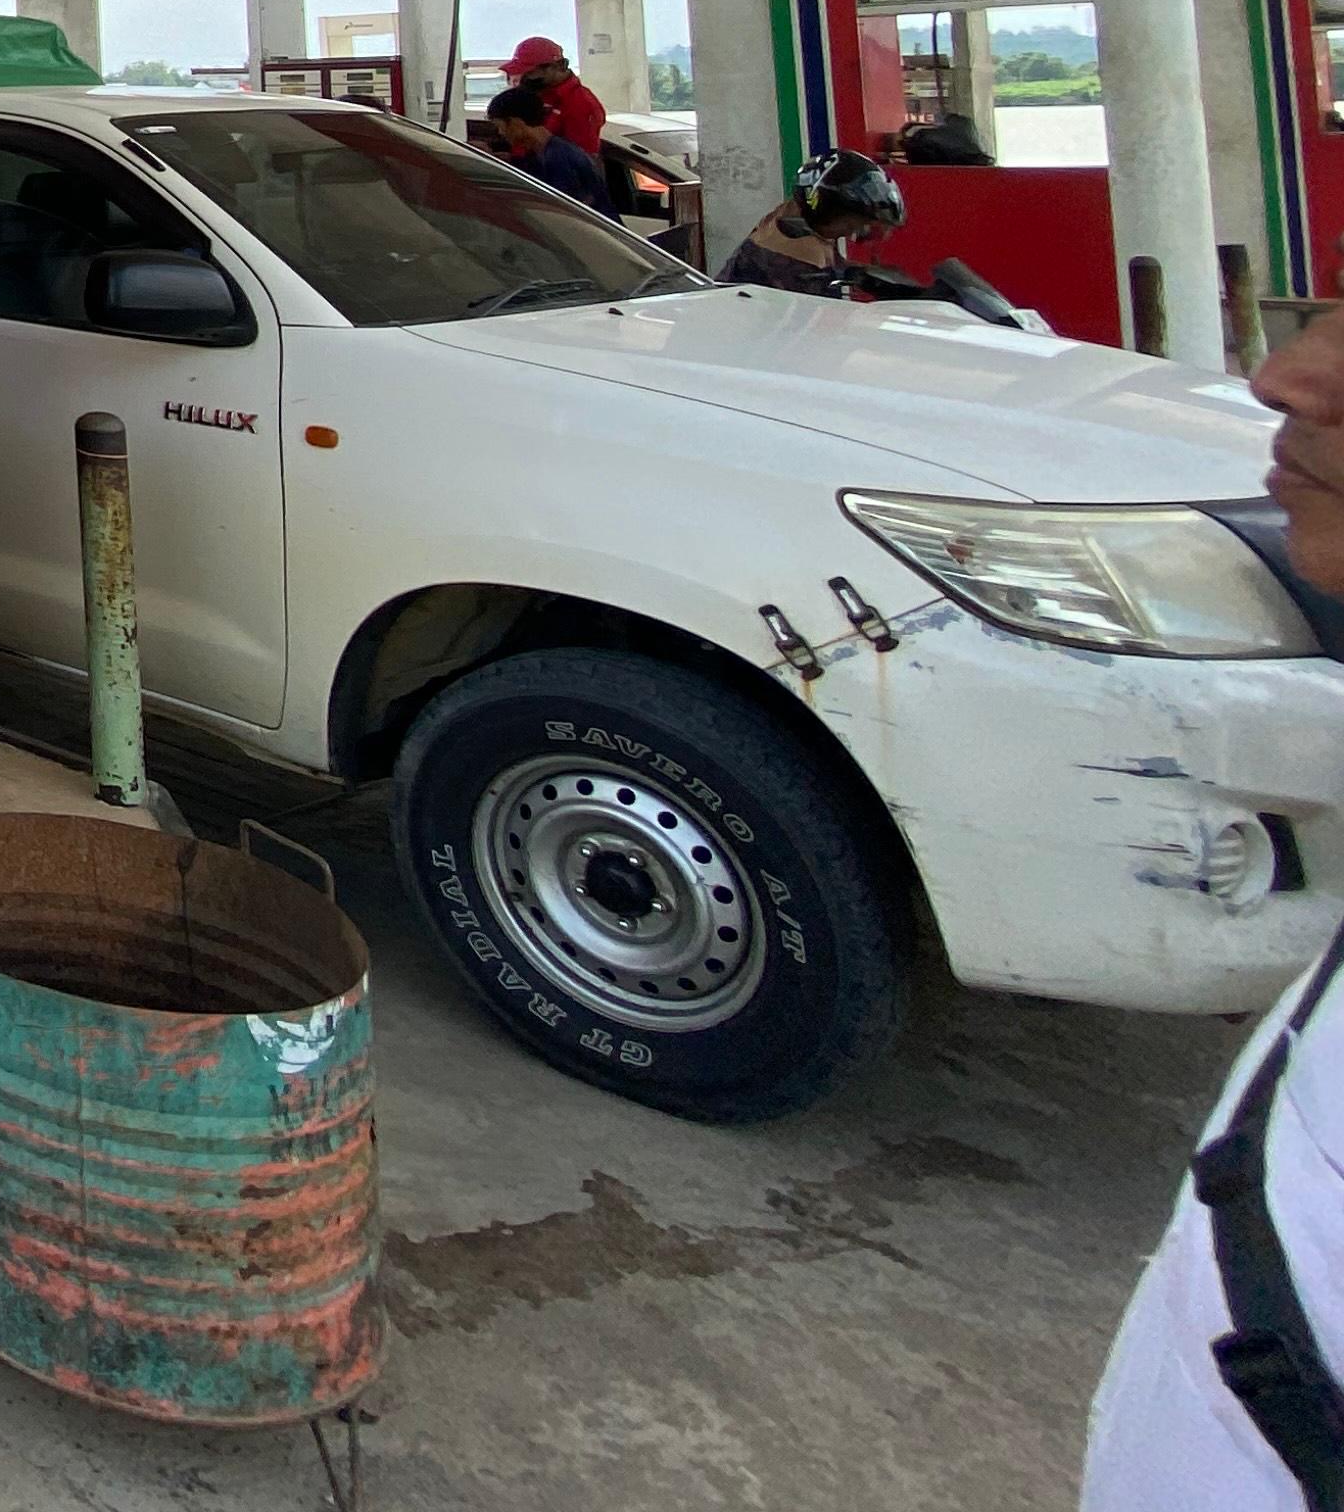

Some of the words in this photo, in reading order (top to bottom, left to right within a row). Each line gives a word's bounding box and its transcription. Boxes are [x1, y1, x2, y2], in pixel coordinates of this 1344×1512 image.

[165, 400, 258, 435] HILUX
[544, 720, 755, 843] SAVERO
[760, 868, 807, 964] A/T
[431, 844, 568, 1027] RADIAL
[580, 1027, 654, 1067] GT
